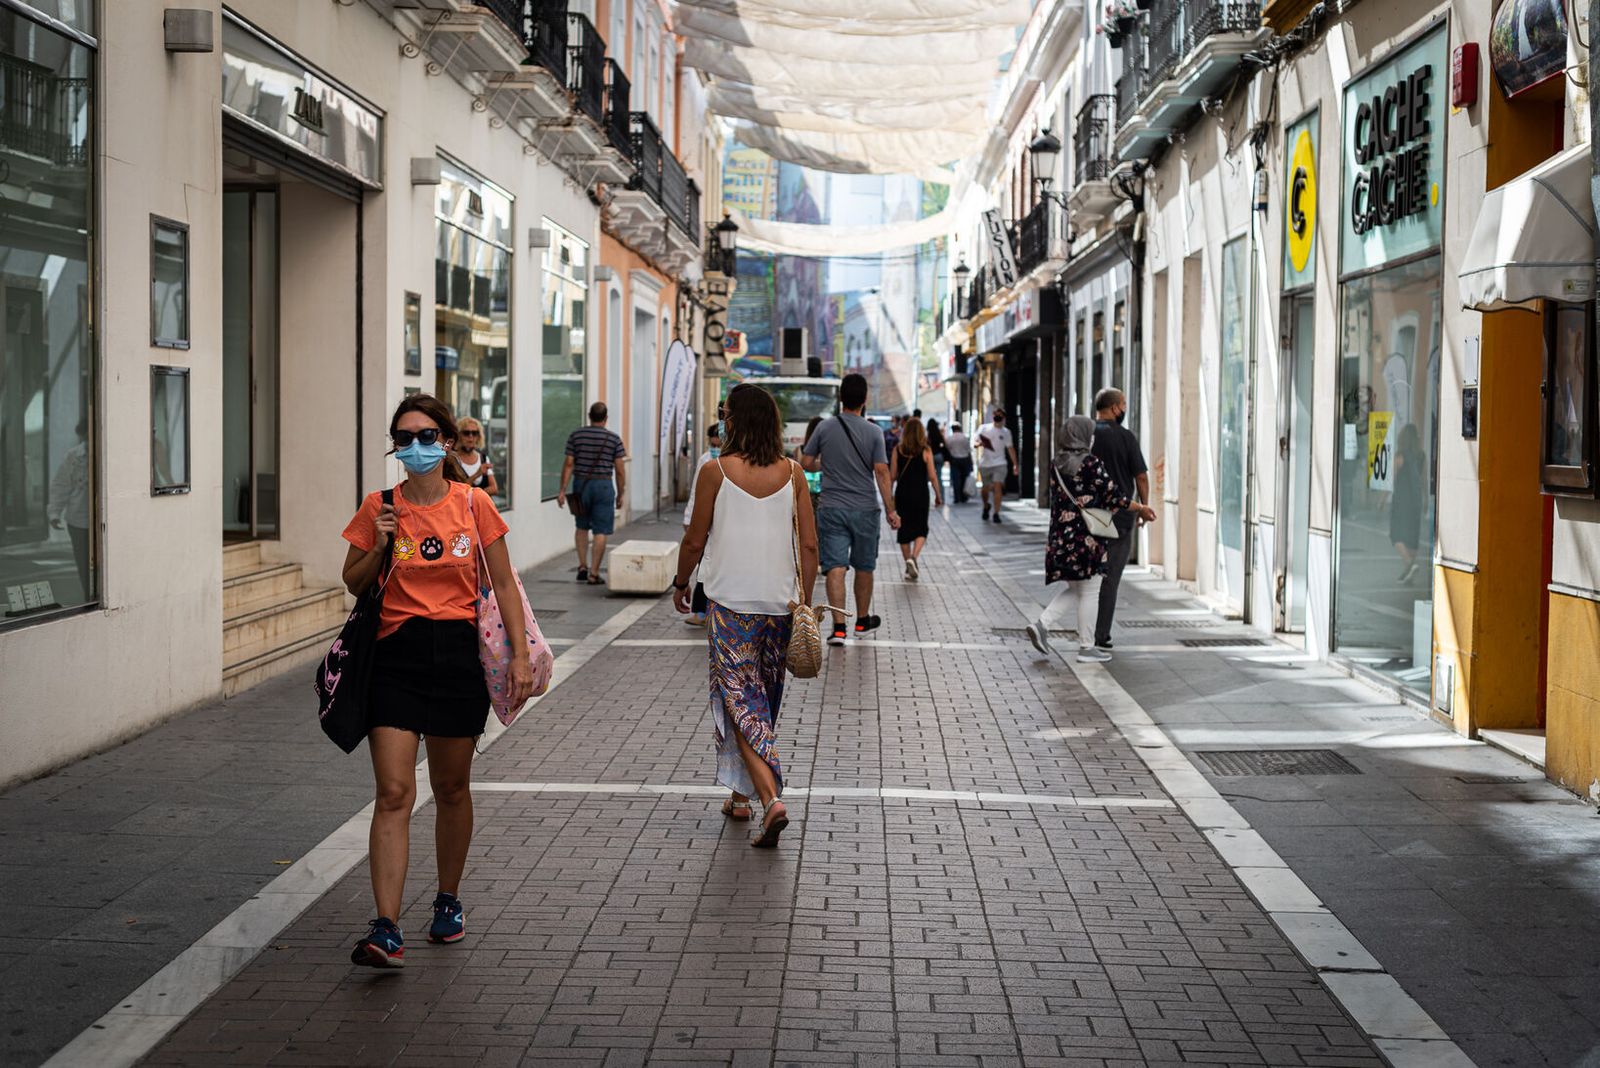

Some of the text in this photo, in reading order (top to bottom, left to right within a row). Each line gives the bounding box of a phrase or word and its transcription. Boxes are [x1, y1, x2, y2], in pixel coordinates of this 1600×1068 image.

[1354, 65, 1431, 165] CACHE
[1292, 166, 1307, 240] C
[985, 209, 1014, 284] FUSION
[704, 281, 727, 357] LOVE
